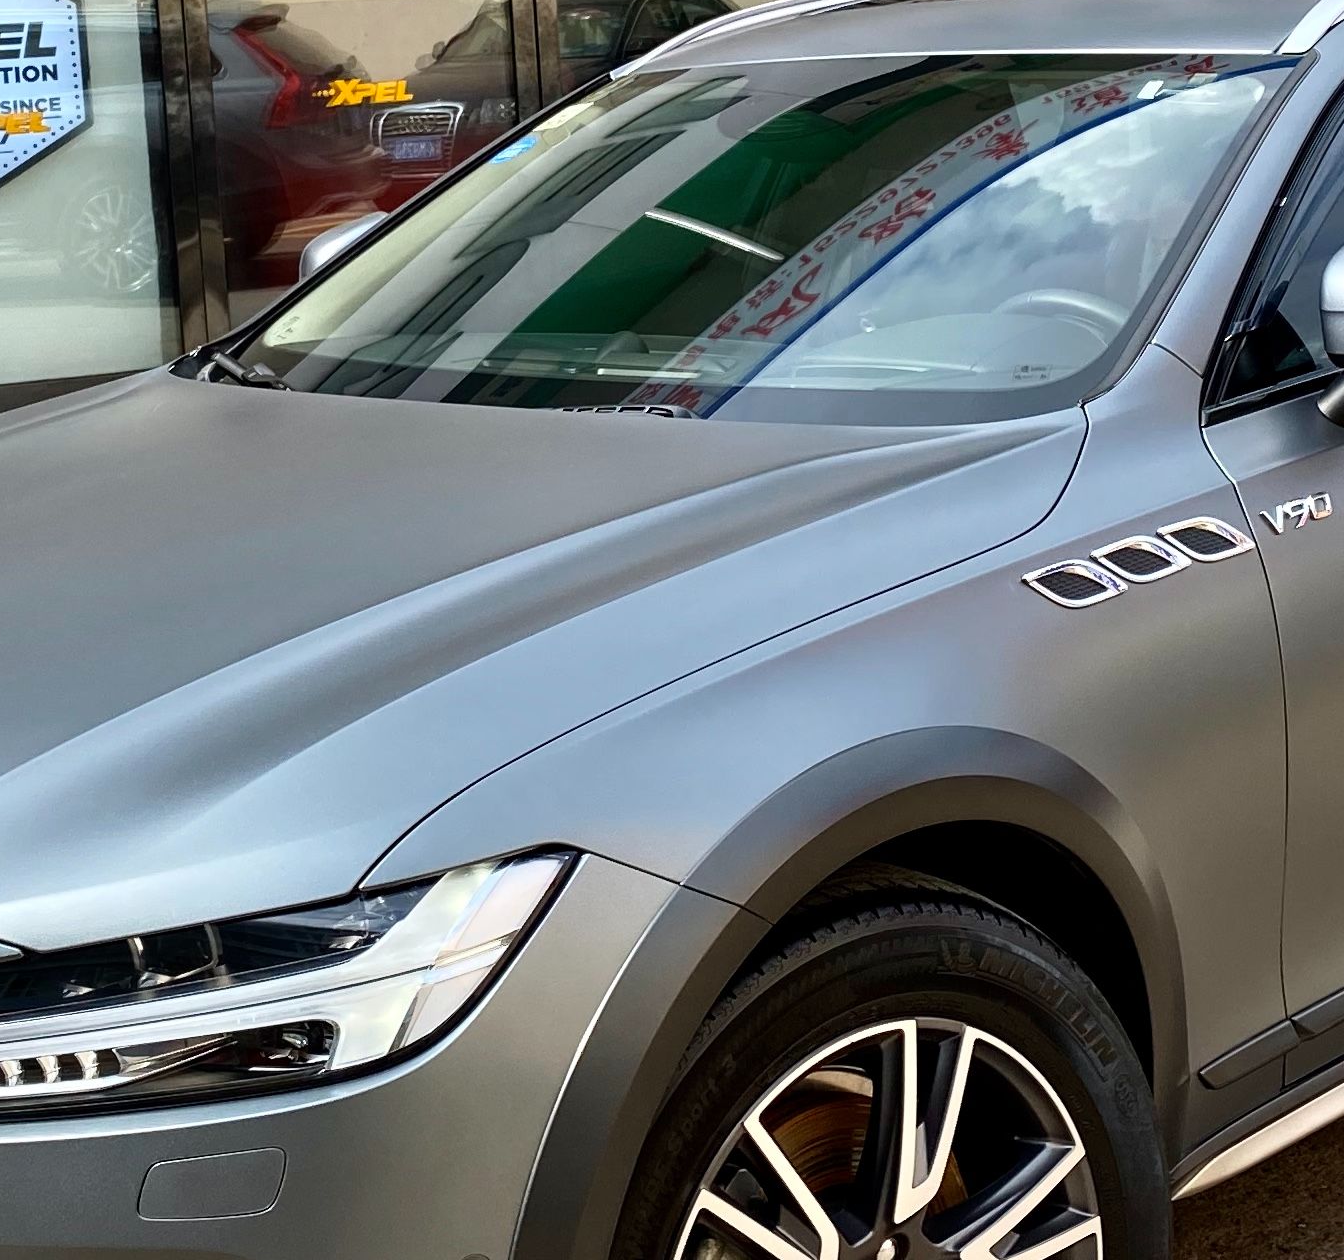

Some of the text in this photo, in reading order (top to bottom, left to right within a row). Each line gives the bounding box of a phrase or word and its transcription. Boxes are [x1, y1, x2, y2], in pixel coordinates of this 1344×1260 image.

[0, 97, 62, 114] SINCE
[326, 79, 414, 107] XPEL
[1259, 492, 1334, 535] V90
[978, 946, 1119, 1069] MICHELIN
